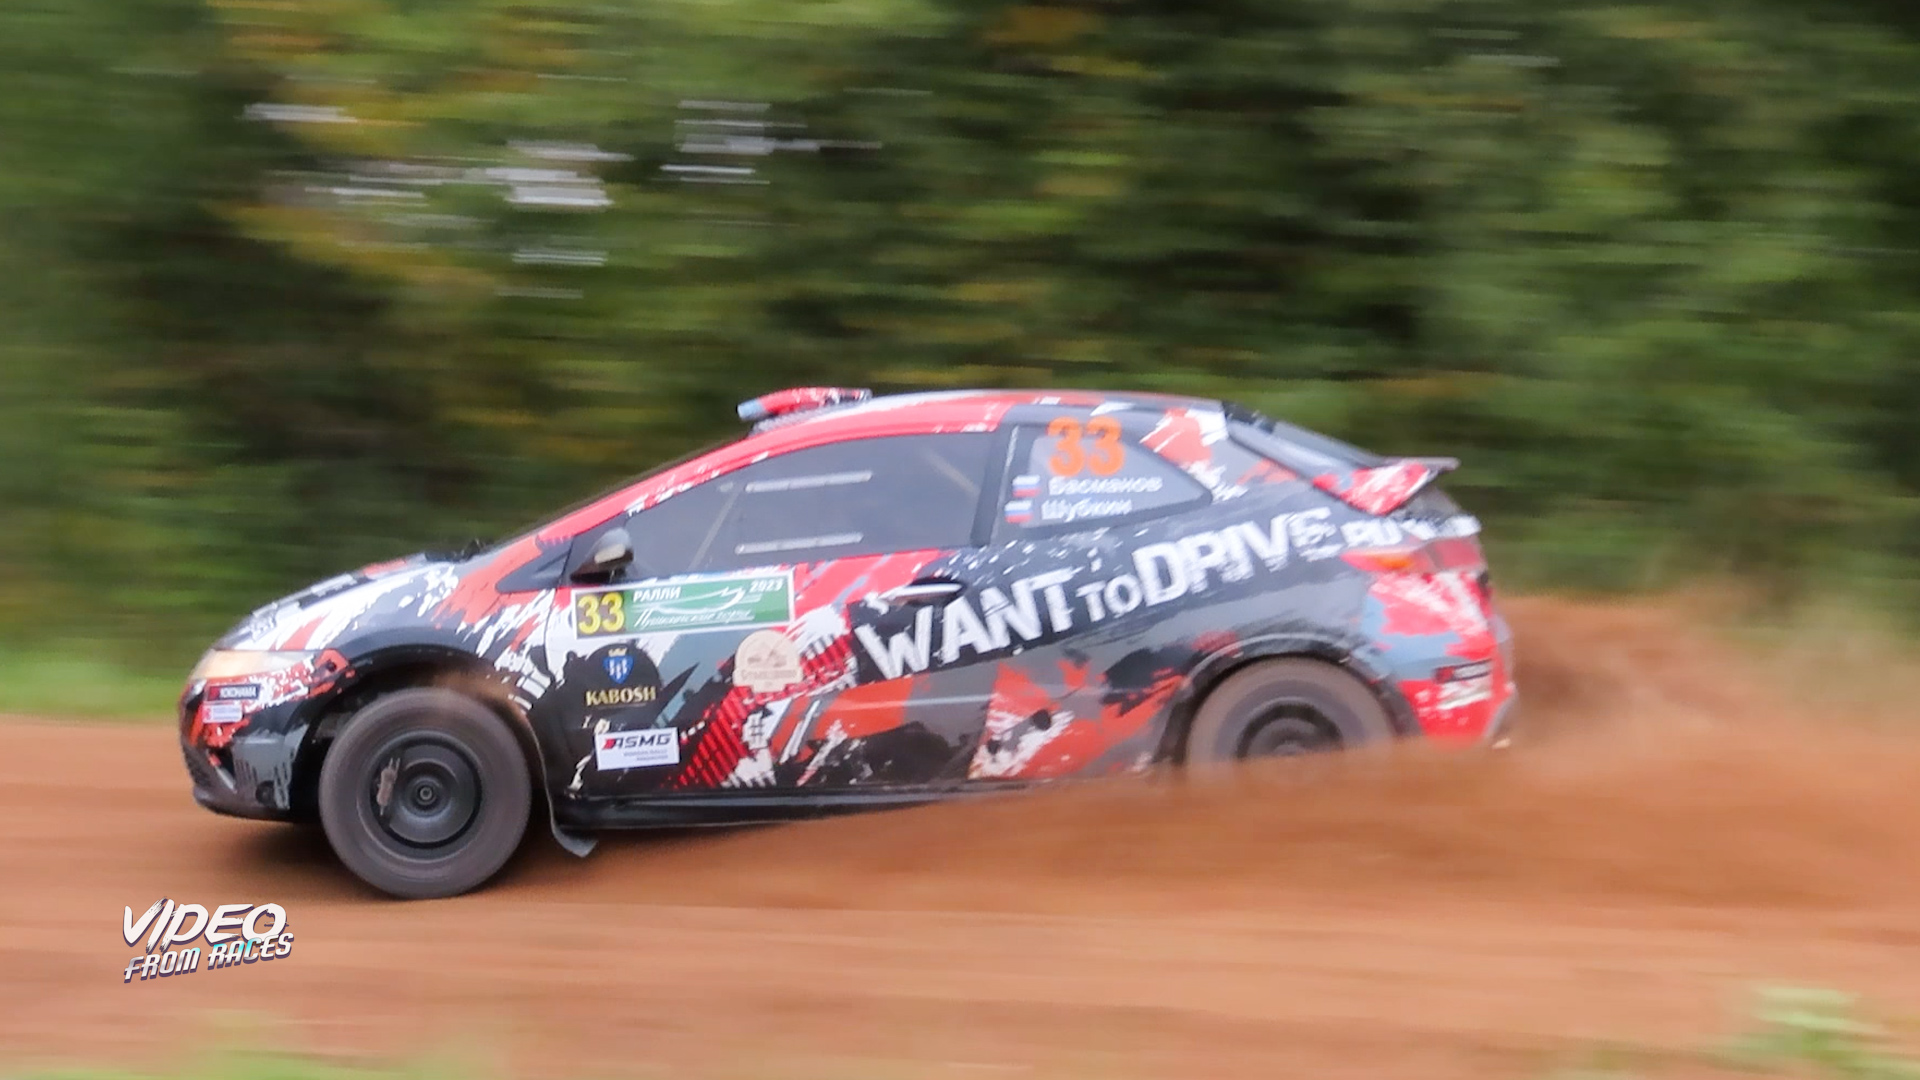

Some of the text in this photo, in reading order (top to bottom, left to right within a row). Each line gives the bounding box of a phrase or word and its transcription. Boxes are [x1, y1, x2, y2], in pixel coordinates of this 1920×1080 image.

[1047, 416, 1126, 477] 33
[1049, 476, 1163, 495] Басманов
[1041, 498, 1132, 522] Шубкин
[633, 586, 681, 602] РАЛЛИ
[750, 578, 783, 594] 2023
[854, 567, 1080, 680] WANT
[1132, 507, 1340, 607] DRIVE
[577, 591, 625, 635] 33
[586, 686, 656, 706] KABOSH
[602, 732, 671, 750] ASMG
